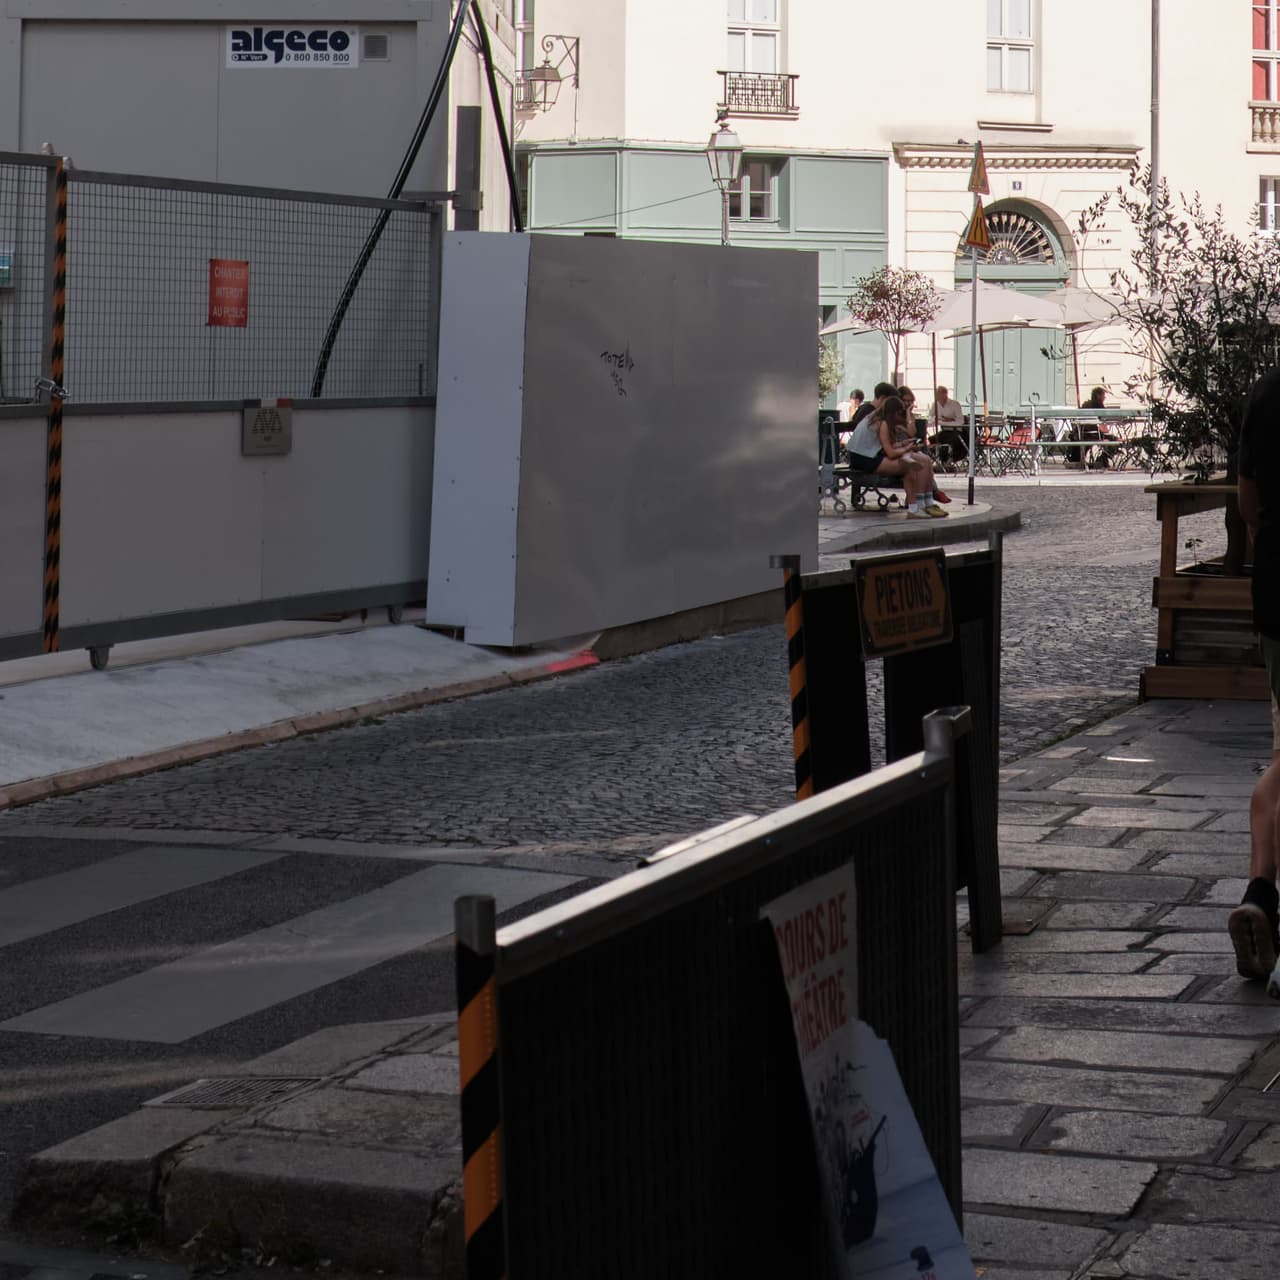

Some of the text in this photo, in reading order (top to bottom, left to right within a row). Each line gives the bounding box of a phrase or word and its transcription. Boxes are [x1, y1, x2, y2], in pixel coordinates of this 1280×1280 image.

[232, 27, 350, 64] algeco
[285, 53, 291, 61] 0
[294, 53, 310, 61] 800
[313, 53, 330, 61] 850
[333, 53, 350, 61] 800
[828, 890, 849, 956] DE
